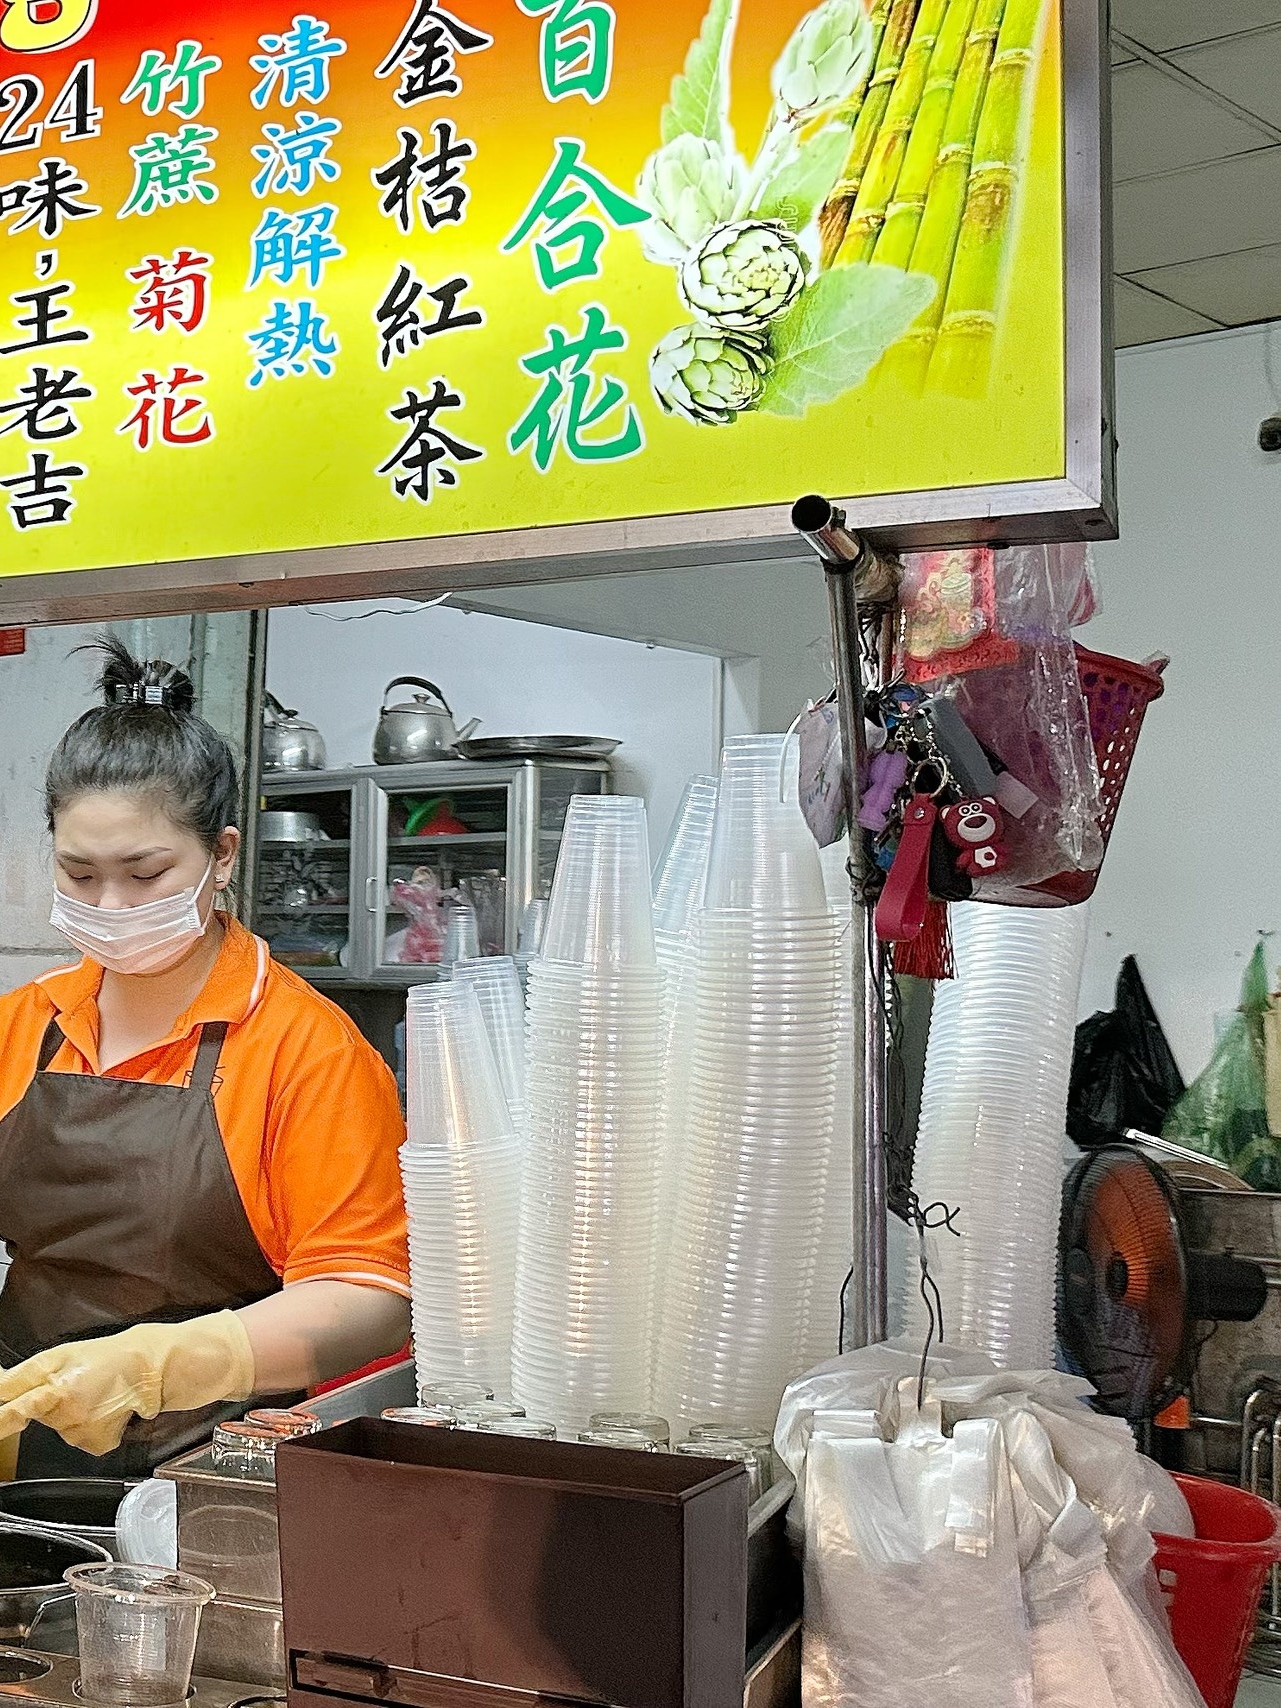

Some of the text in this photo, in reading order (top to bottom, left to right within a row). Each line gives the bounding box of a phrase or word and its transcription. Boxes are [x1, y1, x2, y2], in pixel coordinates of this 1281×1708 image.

[119, 42, 222, 220] 竹蔗
[245, 16, 347, 390] 清涼解熱
[374, 0, 494, 506] 金桔紅茶
[117, 247, 216, 451] 菊花
